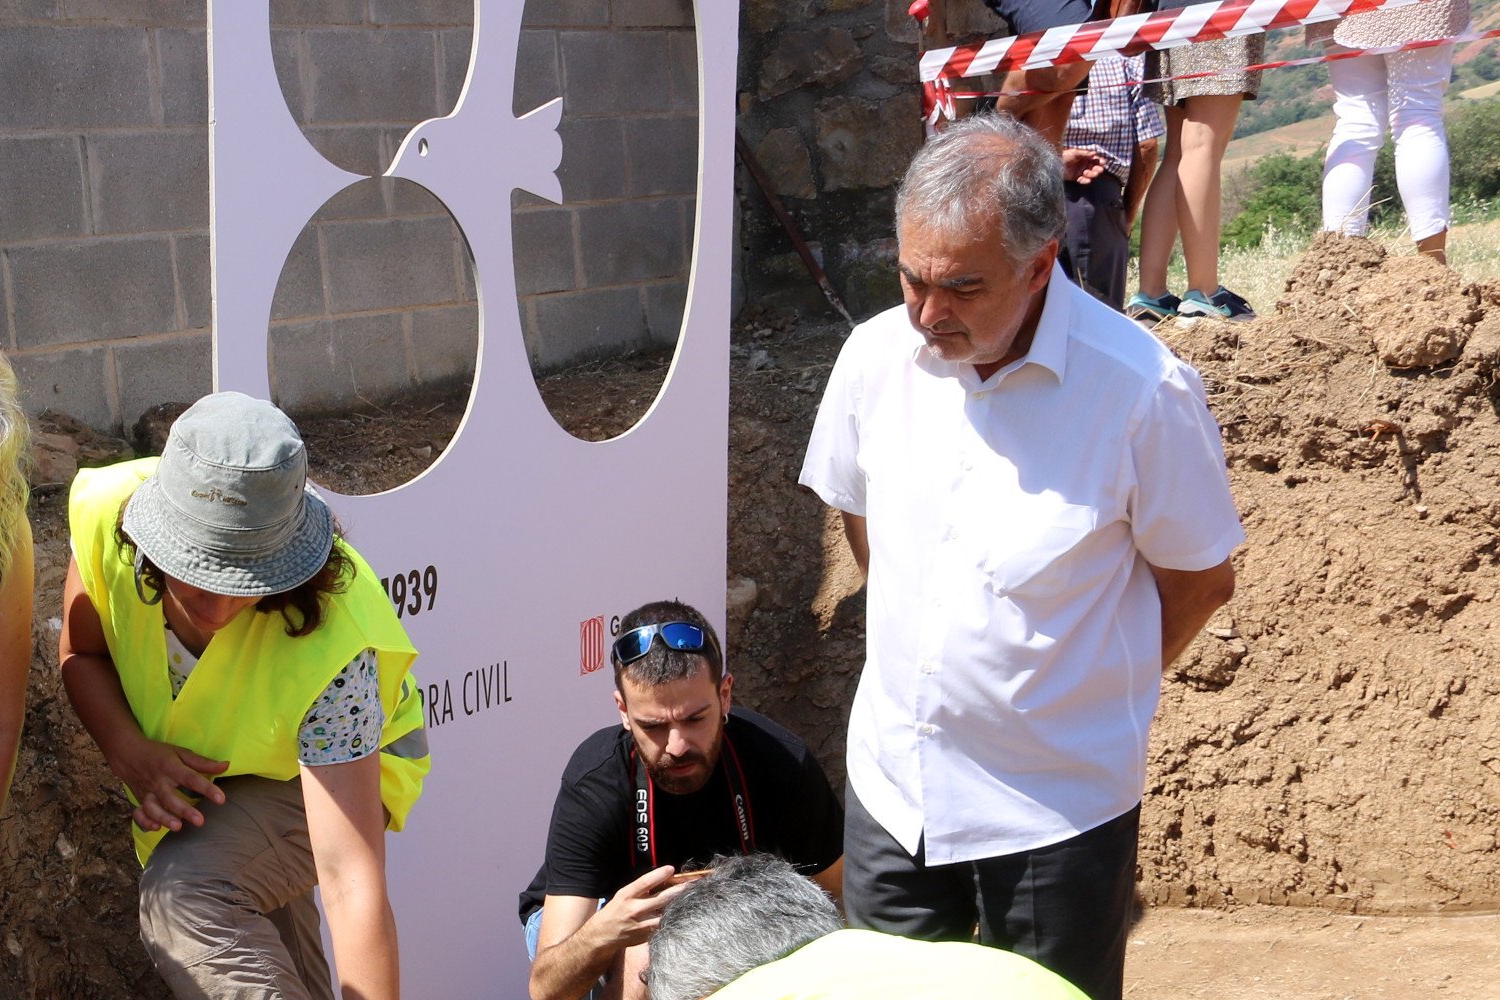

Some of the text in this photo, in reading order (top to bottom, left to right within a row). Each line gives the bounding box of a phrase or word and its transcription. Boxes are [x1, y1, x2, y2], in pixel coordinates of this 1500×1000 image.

[417, 660, 512, 728] RA CIVIL
[636, 788, 649, 852] EOS 60D
[735, 793, 750, 841] Canon
